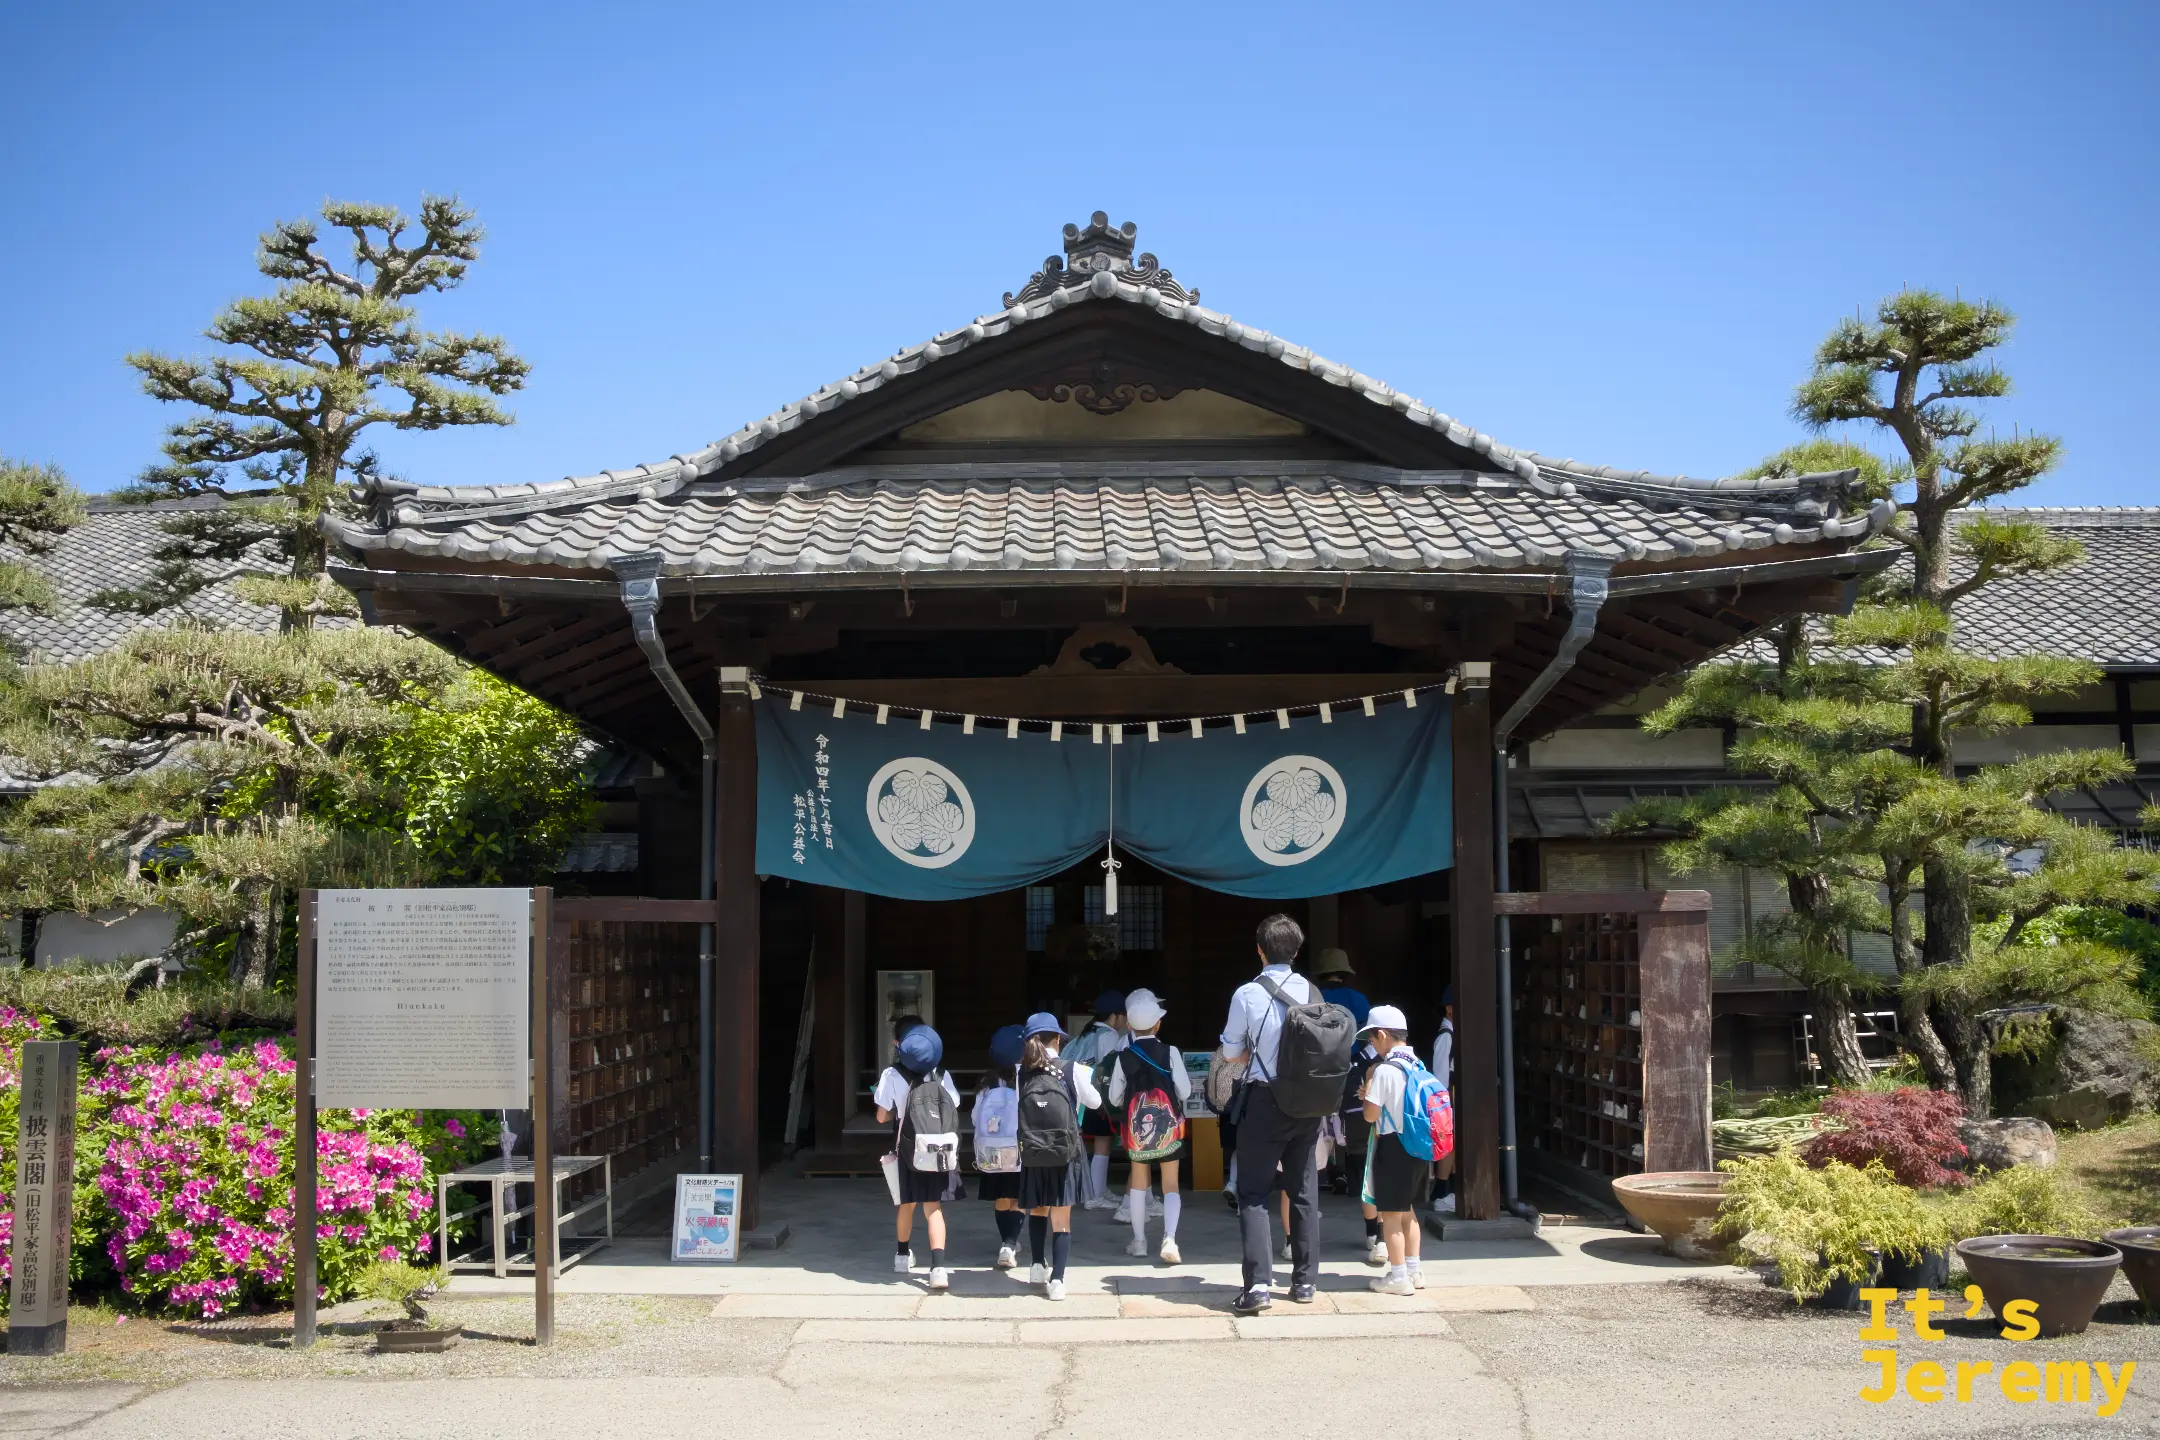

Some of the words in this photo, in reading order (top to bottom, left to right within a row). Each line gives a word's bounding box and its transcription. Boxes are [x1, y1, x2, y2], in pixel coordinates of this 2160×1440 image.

[814, 733, 834, 850] 令和四年七月吉日
[792, 793, 807, 865] 松平公益会
[32, 1053, 45, 1111] 重要文化財
[685, 1216, 729, 1228] 火気厳禁
